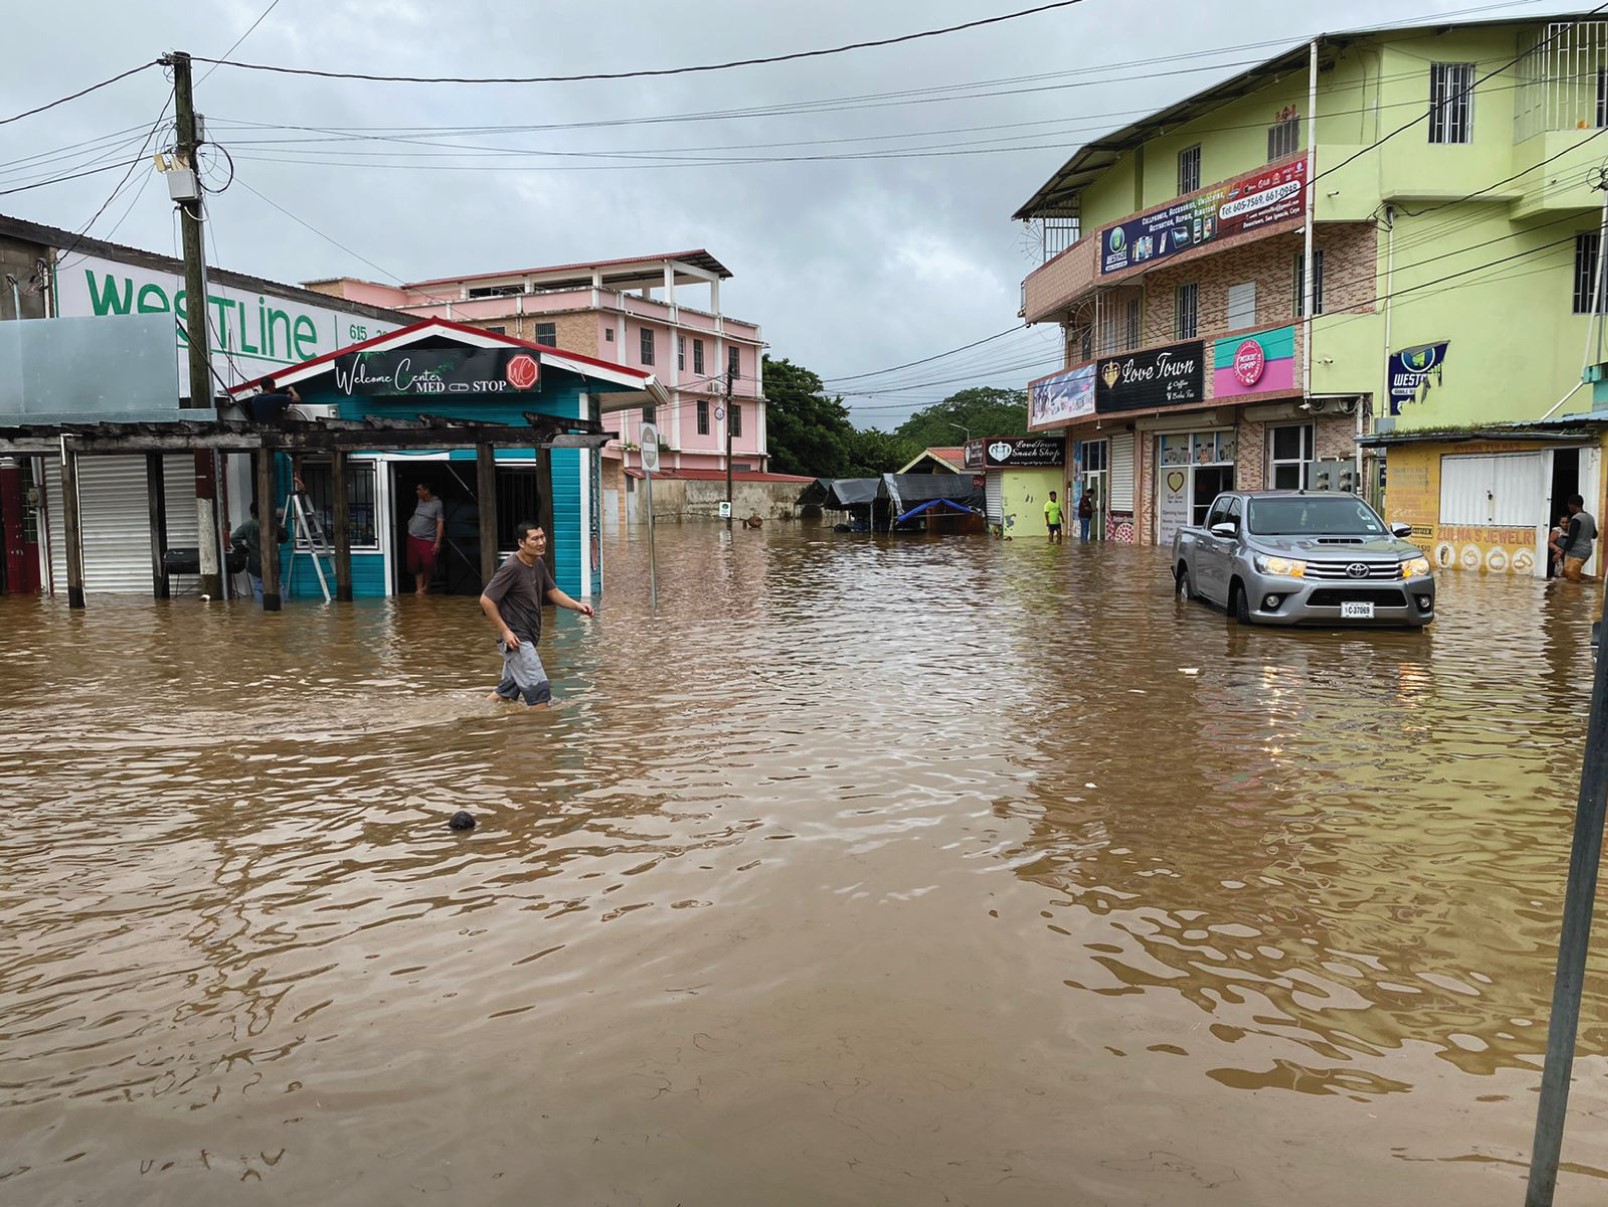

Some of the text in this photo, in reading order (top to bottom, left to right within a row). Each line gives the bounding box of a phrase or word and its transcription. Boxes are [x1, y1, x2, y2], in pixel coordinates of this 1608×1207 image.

[349, 323, 368, 341] 615
[336, 353, 443, 395] Welcome Center
[1121, 352, 1196, 384] Love Town
[416, 380, 507, 393] MED STOP
[1012, 447, 1060, 462] Snack Shop
